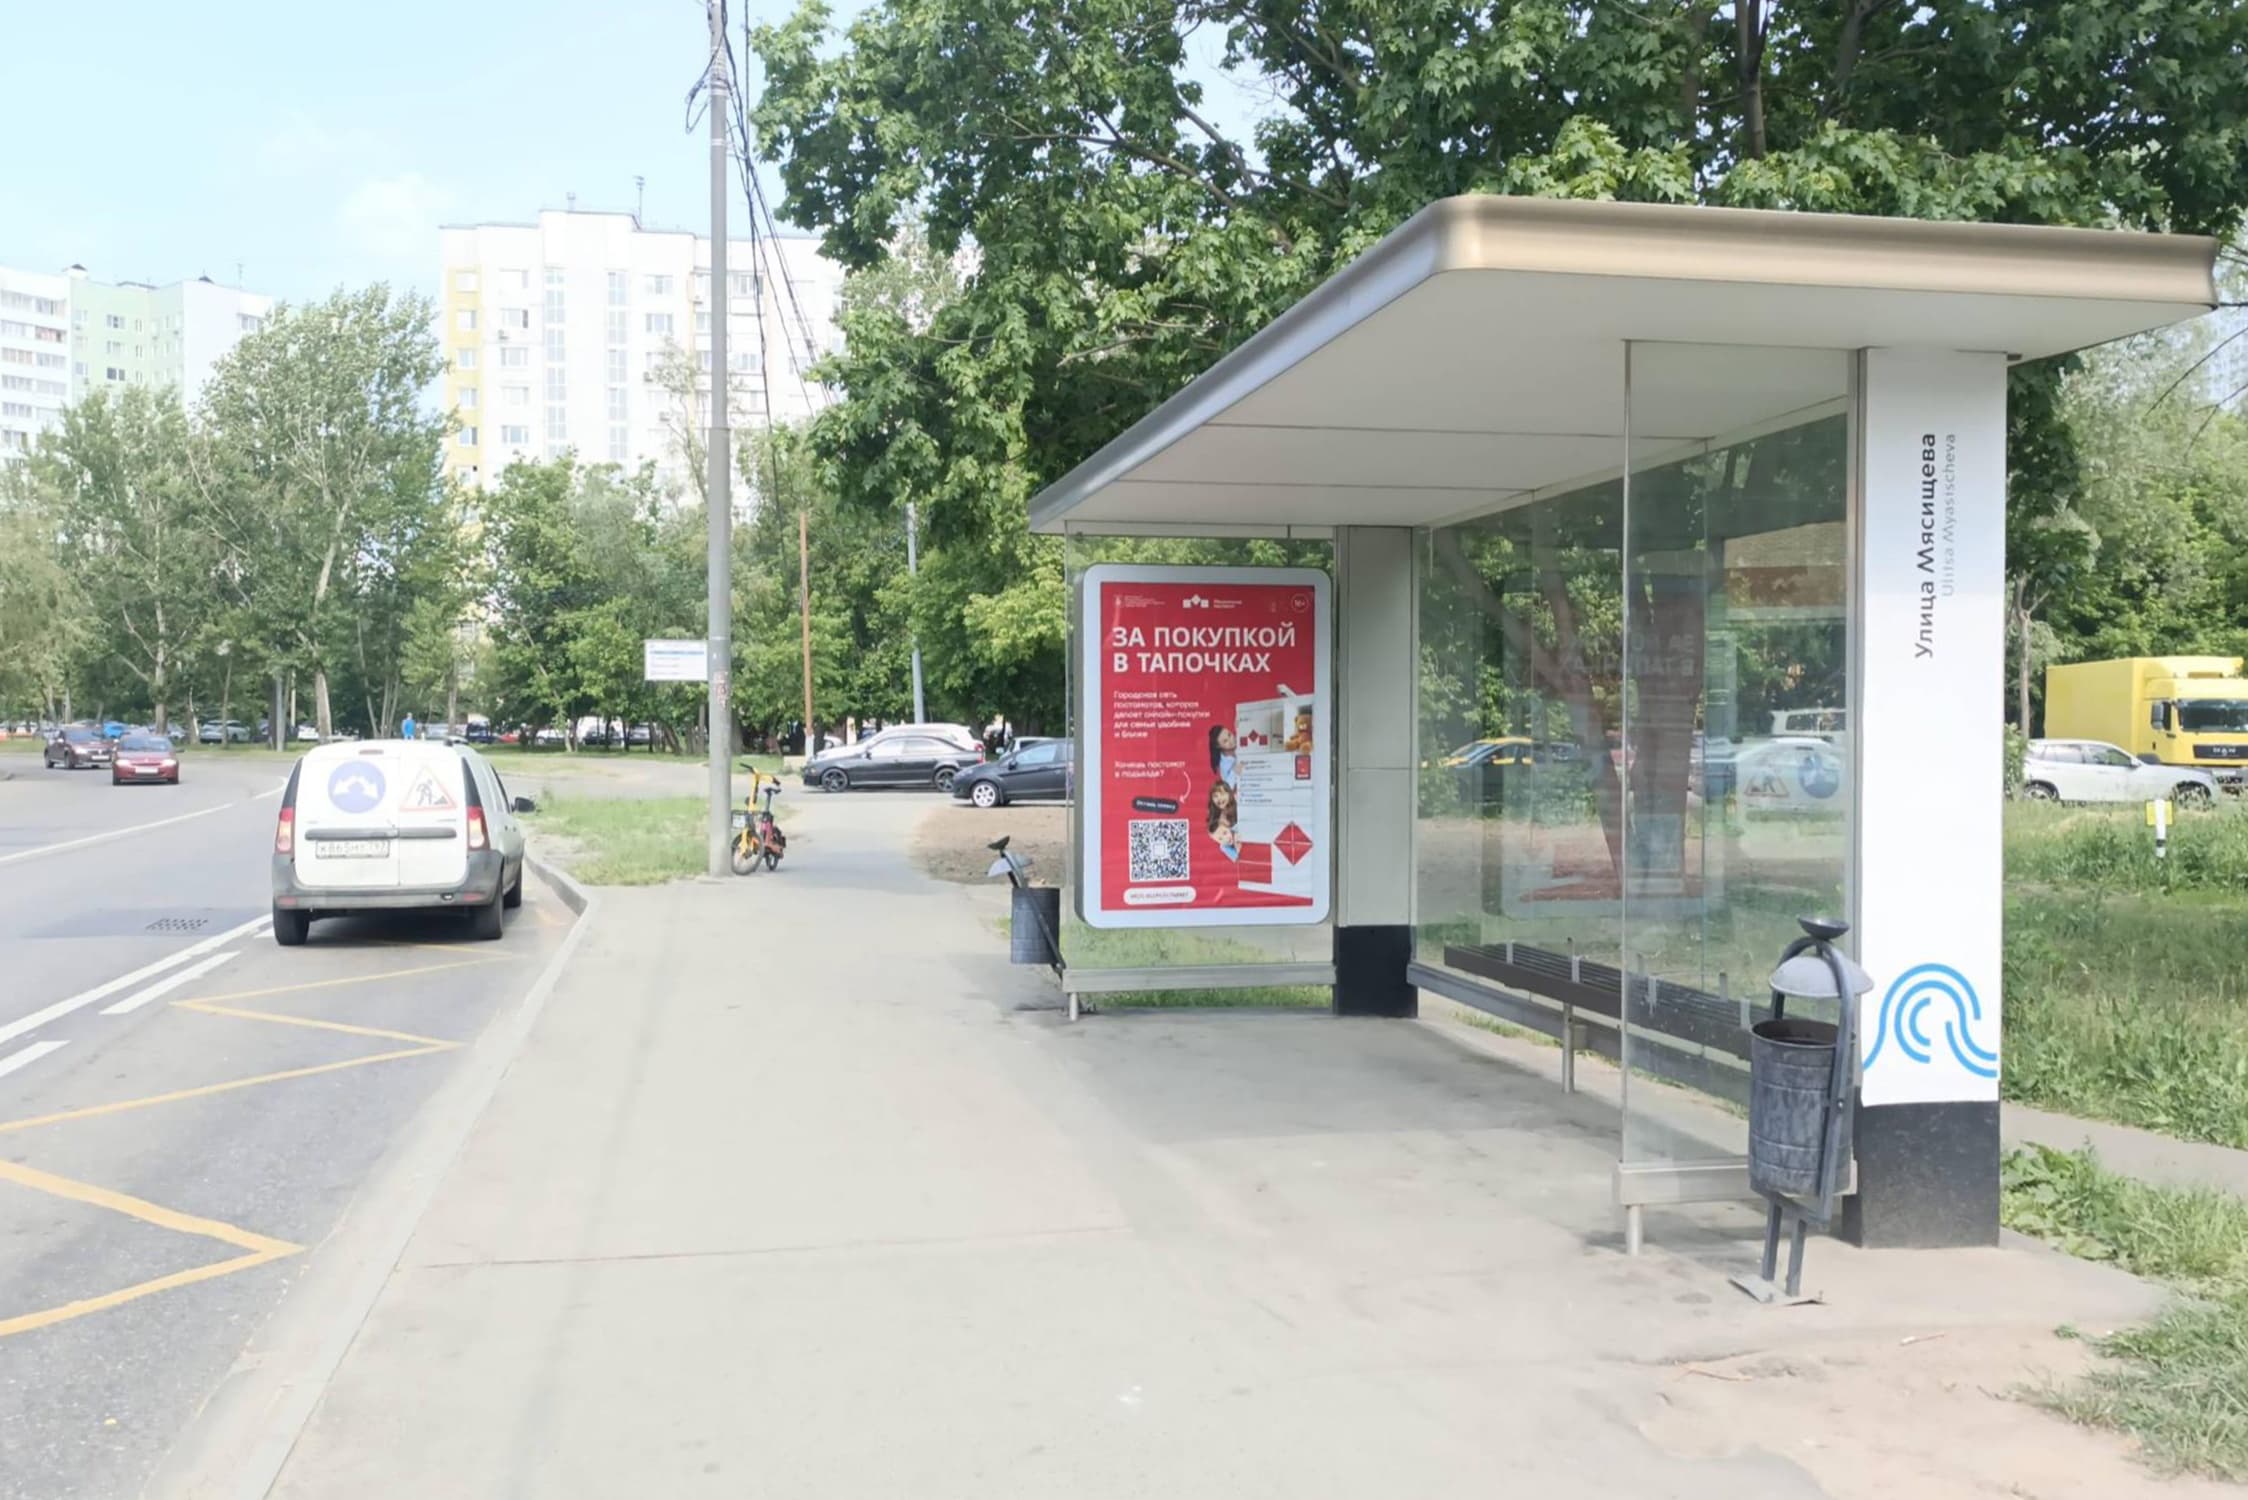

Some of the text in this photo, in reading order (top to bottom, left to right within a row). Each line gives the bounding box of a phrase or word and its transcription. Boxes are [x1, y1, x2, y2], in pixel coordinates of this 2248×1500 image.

[1915, 433, 1938, 659] Улица Мясищева
[1941, 433, 1958, 597] Ulitsa Myasischeva
[1112, 621, 1296, 648] ЗА ПОКУПКОЙ
[1113, 653, 1271, 673] В ТАПОЧКАХ
